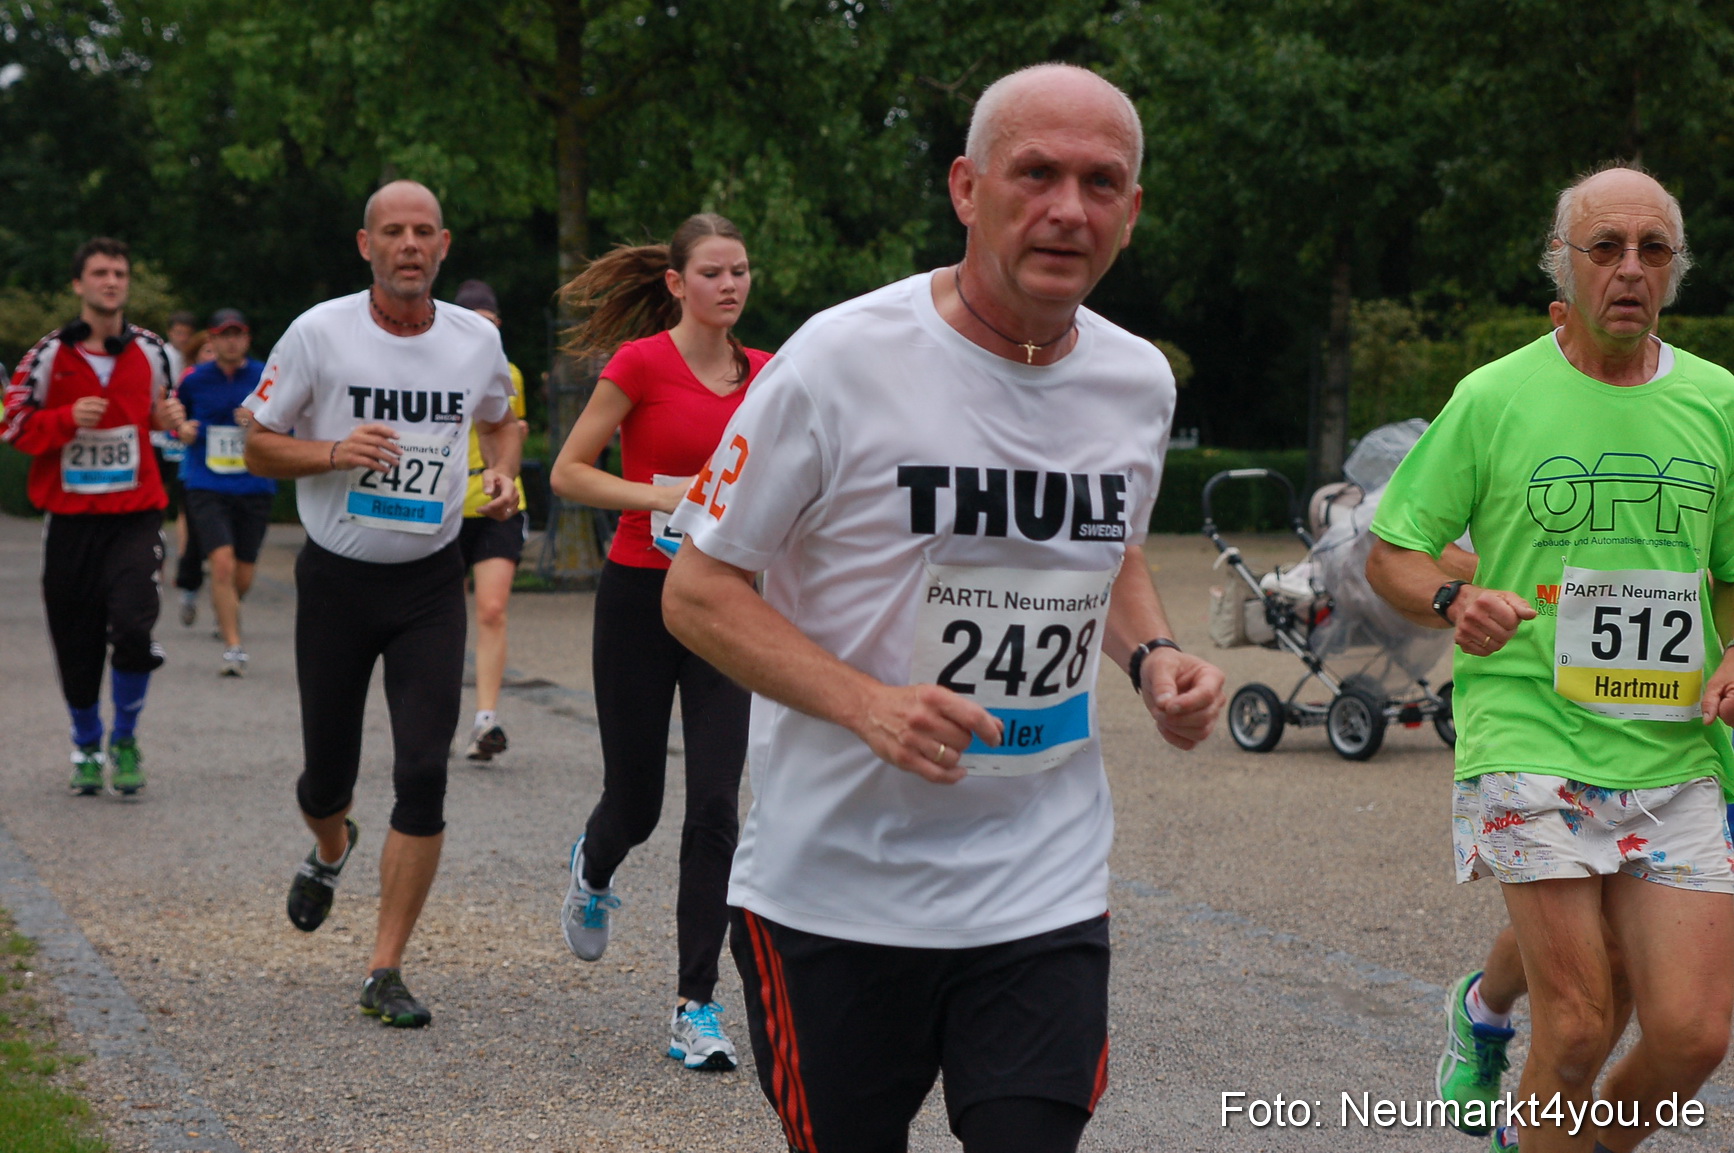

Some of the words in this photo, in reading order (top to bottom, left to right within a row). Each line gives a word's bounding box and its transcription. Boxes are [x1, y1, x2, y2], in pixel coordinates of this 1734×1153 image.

[348, 386, 464, 423] THULE
[70, 443, 130, 467] 2138
[897, 465, 1126, 541] THULE
[1527, 452, 1716, 533] OPF
[372, 501, 425, 519] Richard
[1078, 523, 1124, 538] SWEDEN
[926, 586, 999, 609] PARTL
[1004, 591, 1099, 612] Neumarkt
[1564, 582, 1617, 597] PARTL
[1622, 585, 1697, 602] Neumarkt
[1591, 606, 1693, 664] 512
[936, 618, 1097, 697] 2428
[1595, 675, 1679, 700] Hartmut
